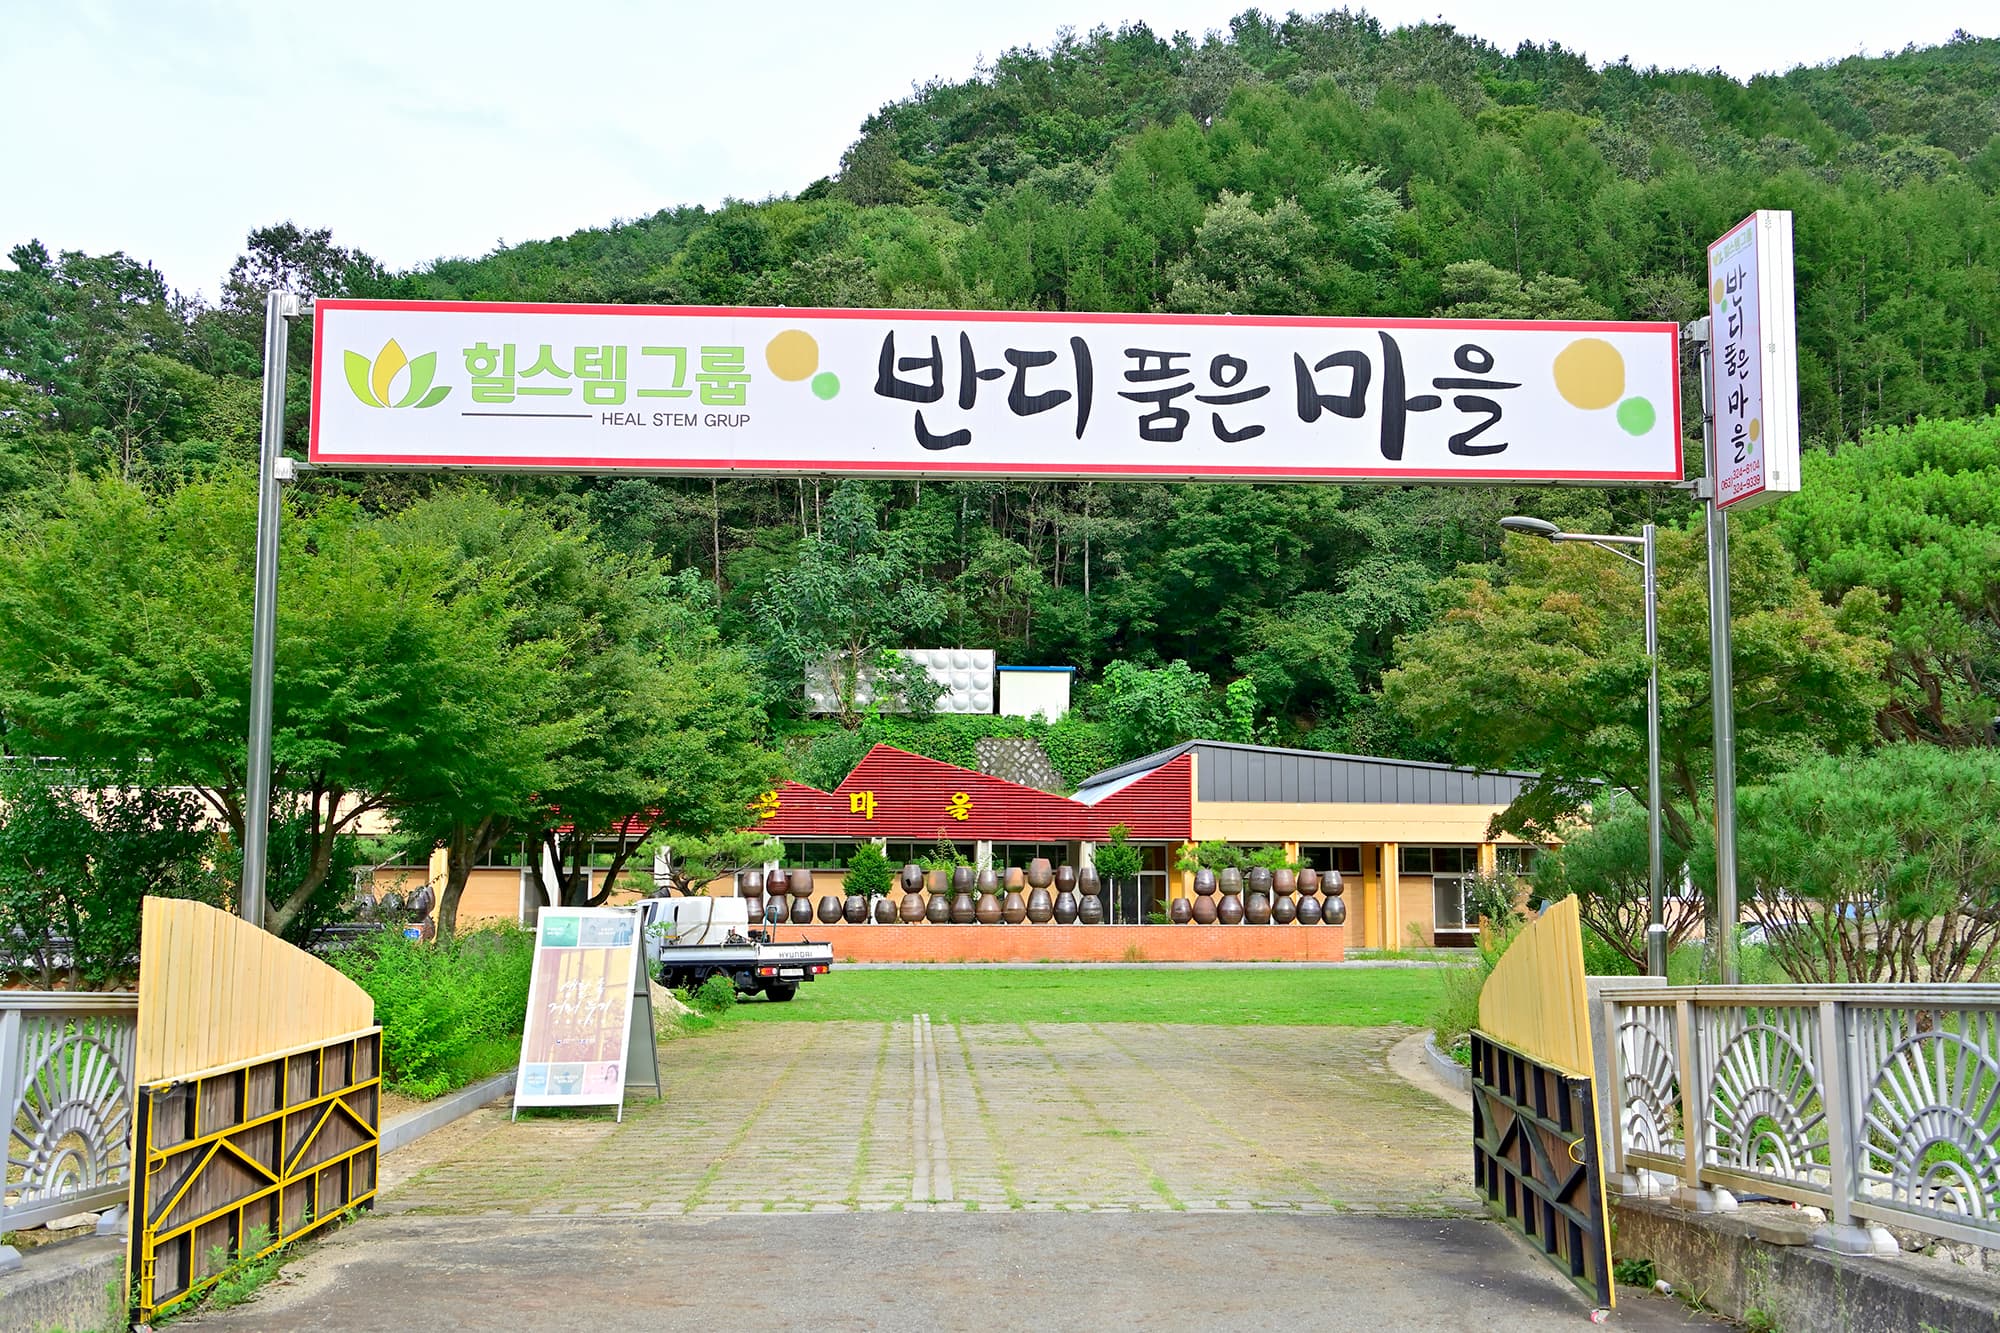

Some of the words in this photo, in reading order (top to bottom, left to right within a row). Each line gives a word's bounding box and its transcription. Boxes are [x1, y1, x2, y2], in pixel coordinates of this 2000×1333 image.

[602, 412, 647, 426] HEAL
[652, 412, 698, 427] STEM
[704, 413, 751, 428] GRUP
[778, 951, 813, 959] HYUNDAI
